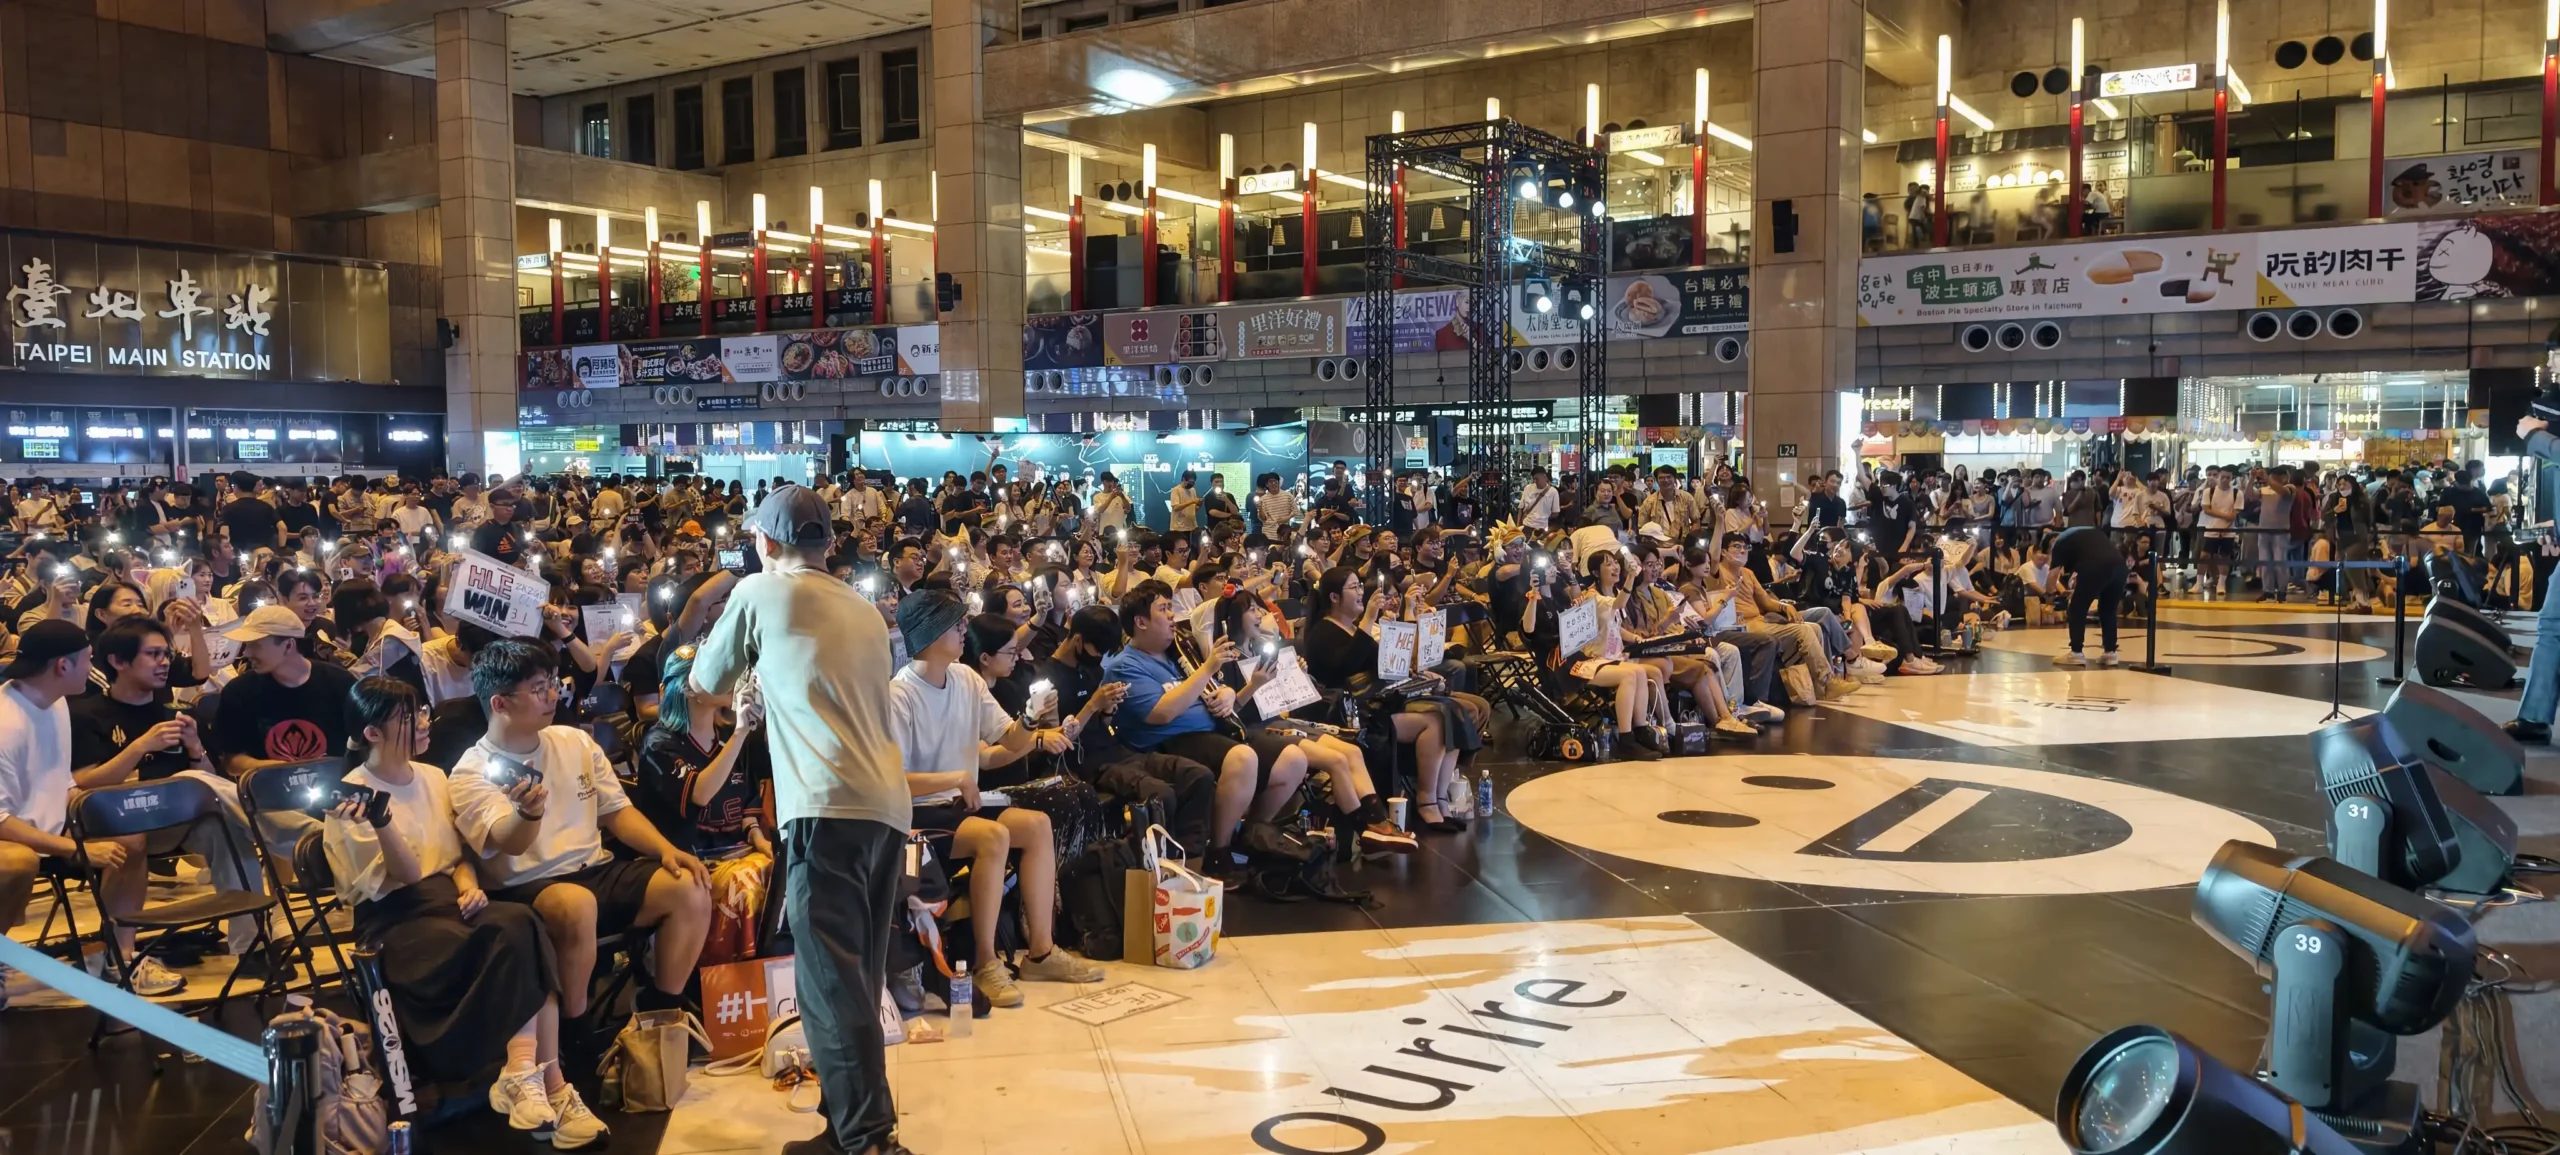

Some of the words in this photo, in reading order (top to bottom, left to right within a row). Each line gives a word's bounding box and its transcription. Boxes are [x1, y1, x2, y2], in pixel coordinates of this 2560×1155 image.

[2447, 155, 2494, 182] 환영
[2449, 172, 2526, 206] 합니다
[1951, 263, 1995, 275] 日日手作
[2266, 248, 2405, 278] 阮的肉干
[1913, 269, 1940, 284] 台中
[2009, 278, 2070, 296] 專賣店
[6, 257, 271, 341] 臺北車站
[1925, 281, 1997, 299] 波士頓派
[1693, 294, 1743, 311] 伴手禮
[1948, 306, 1961, 315] Pie
[1964, 304, 2003, 315] Specialty
[2006, 303, 2029, 313] Store
[2032, 302, 2040, 311] in
[1250, 308, 1322, 334] 里洋好禮
[14, 342, 92, 363] TAIPEI
[109, 347, 167, 366] MAIN
[182, 350, 271, 370] STATION
[1779, 445, 1795, 456] L24
[468, 565, 514, 600] HLE
[464, 589, 511, 621] WIN
[208, 652, 231, 660] IN
[698, 797, 743, 825] LE
[2347, 803, 2370, 821] 31
[2294, 933, 2322, 955] 39
